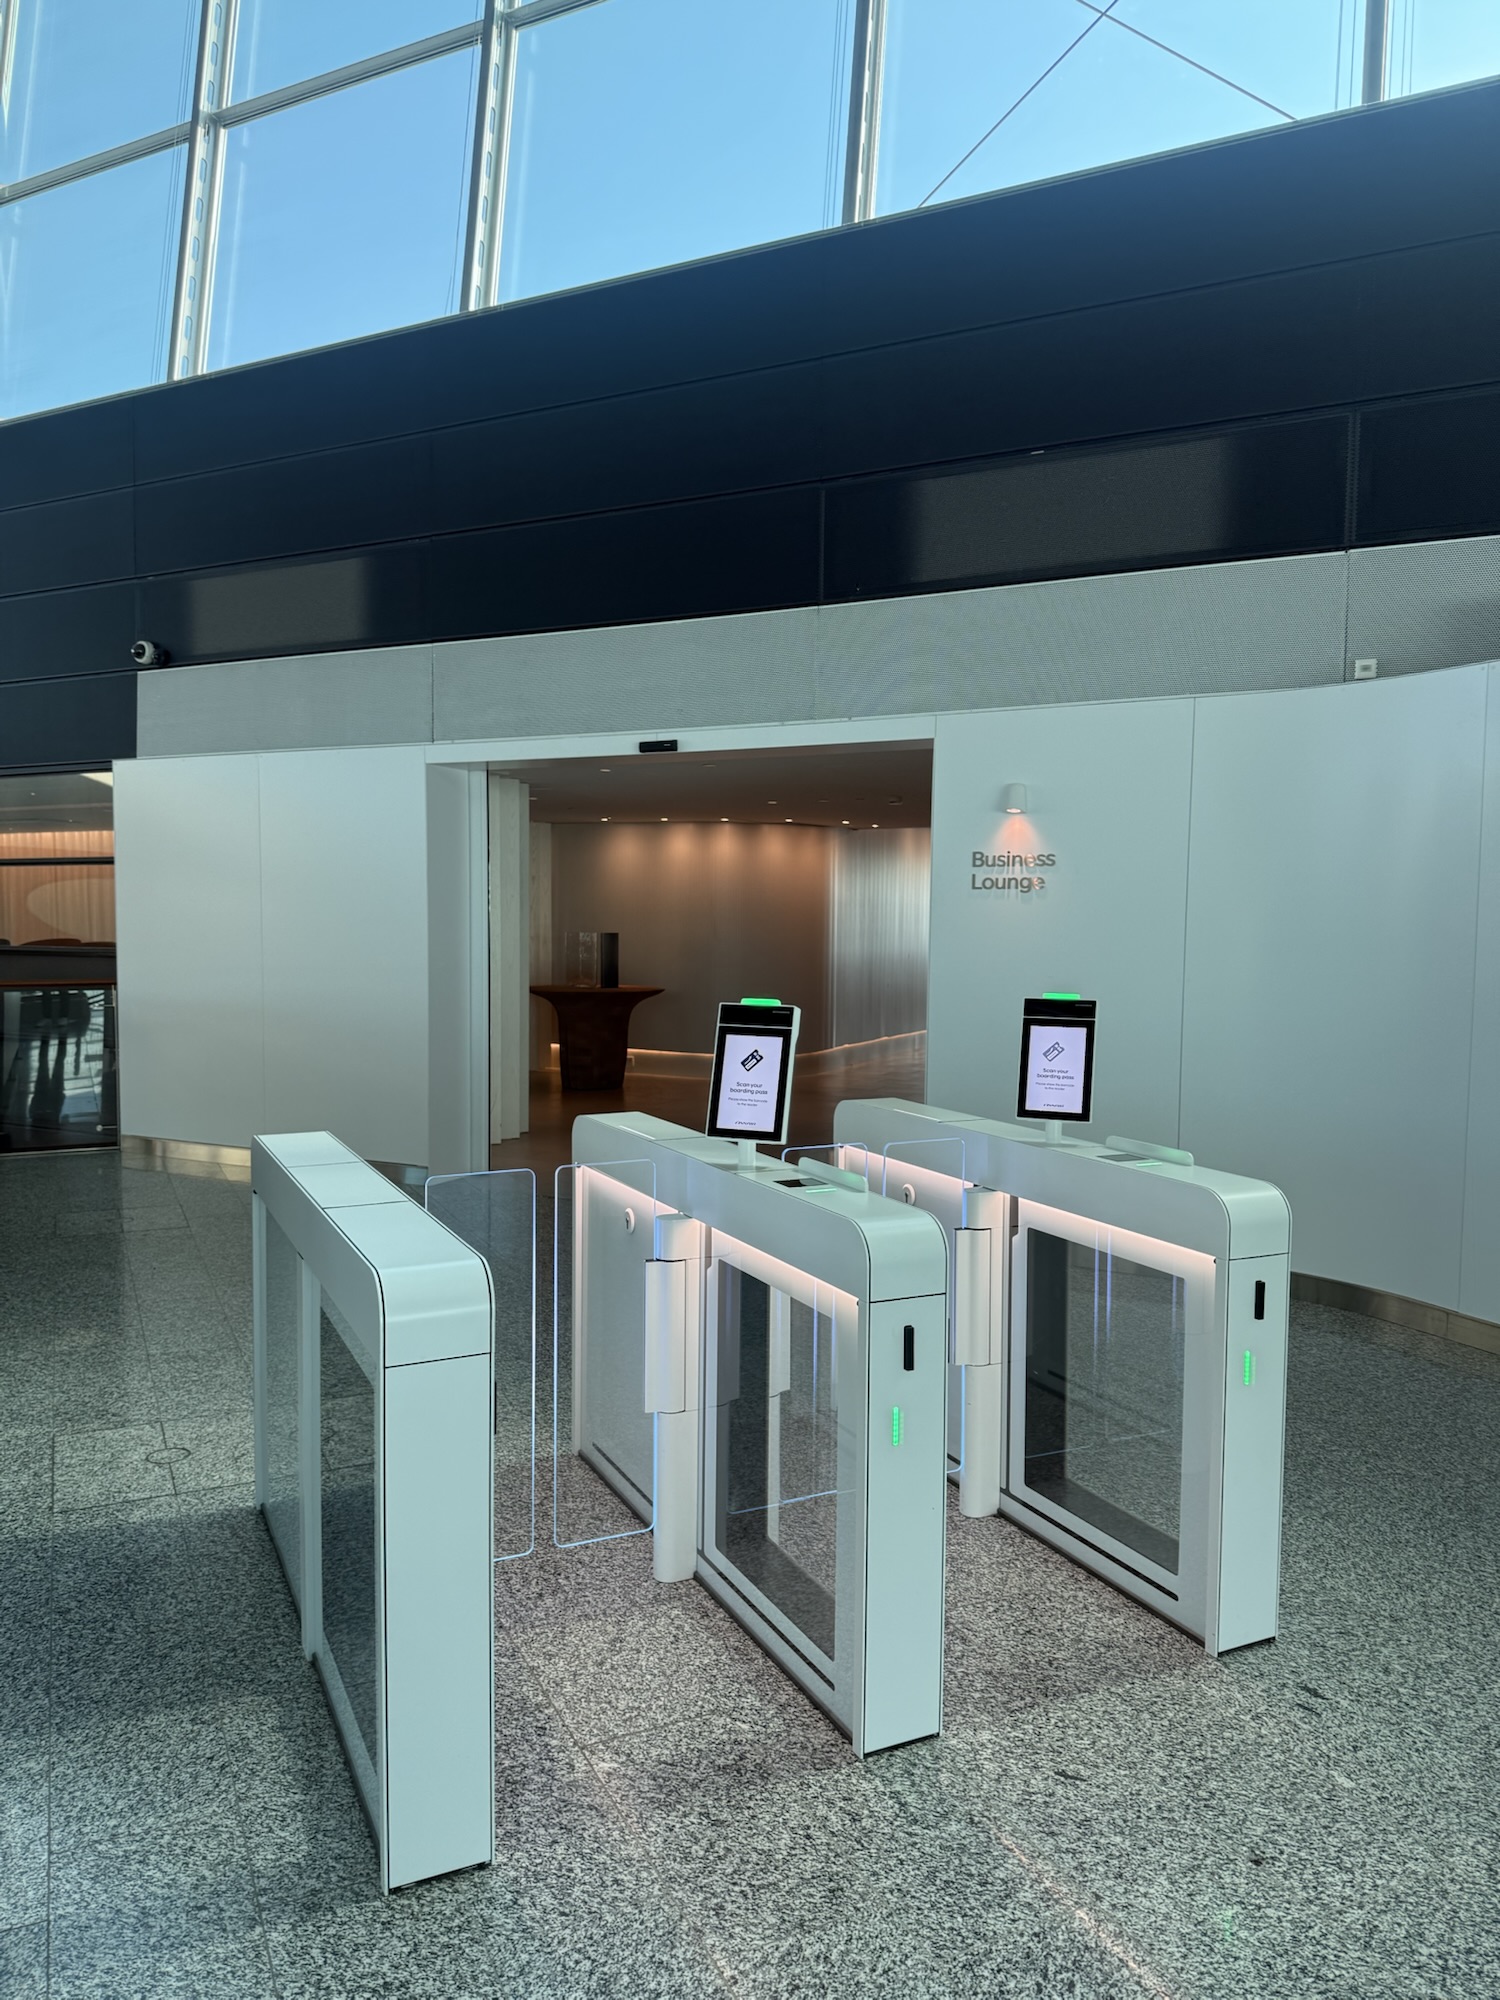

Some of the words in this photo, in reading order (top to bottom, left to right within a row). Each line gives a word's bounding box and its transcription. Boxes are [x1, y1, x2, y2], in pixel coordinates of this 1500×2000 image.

[971, 850, 1056, 868] Business
[971, 873, 1046, 893] Lounge
[729, 1087, 755, 1095] boarding
